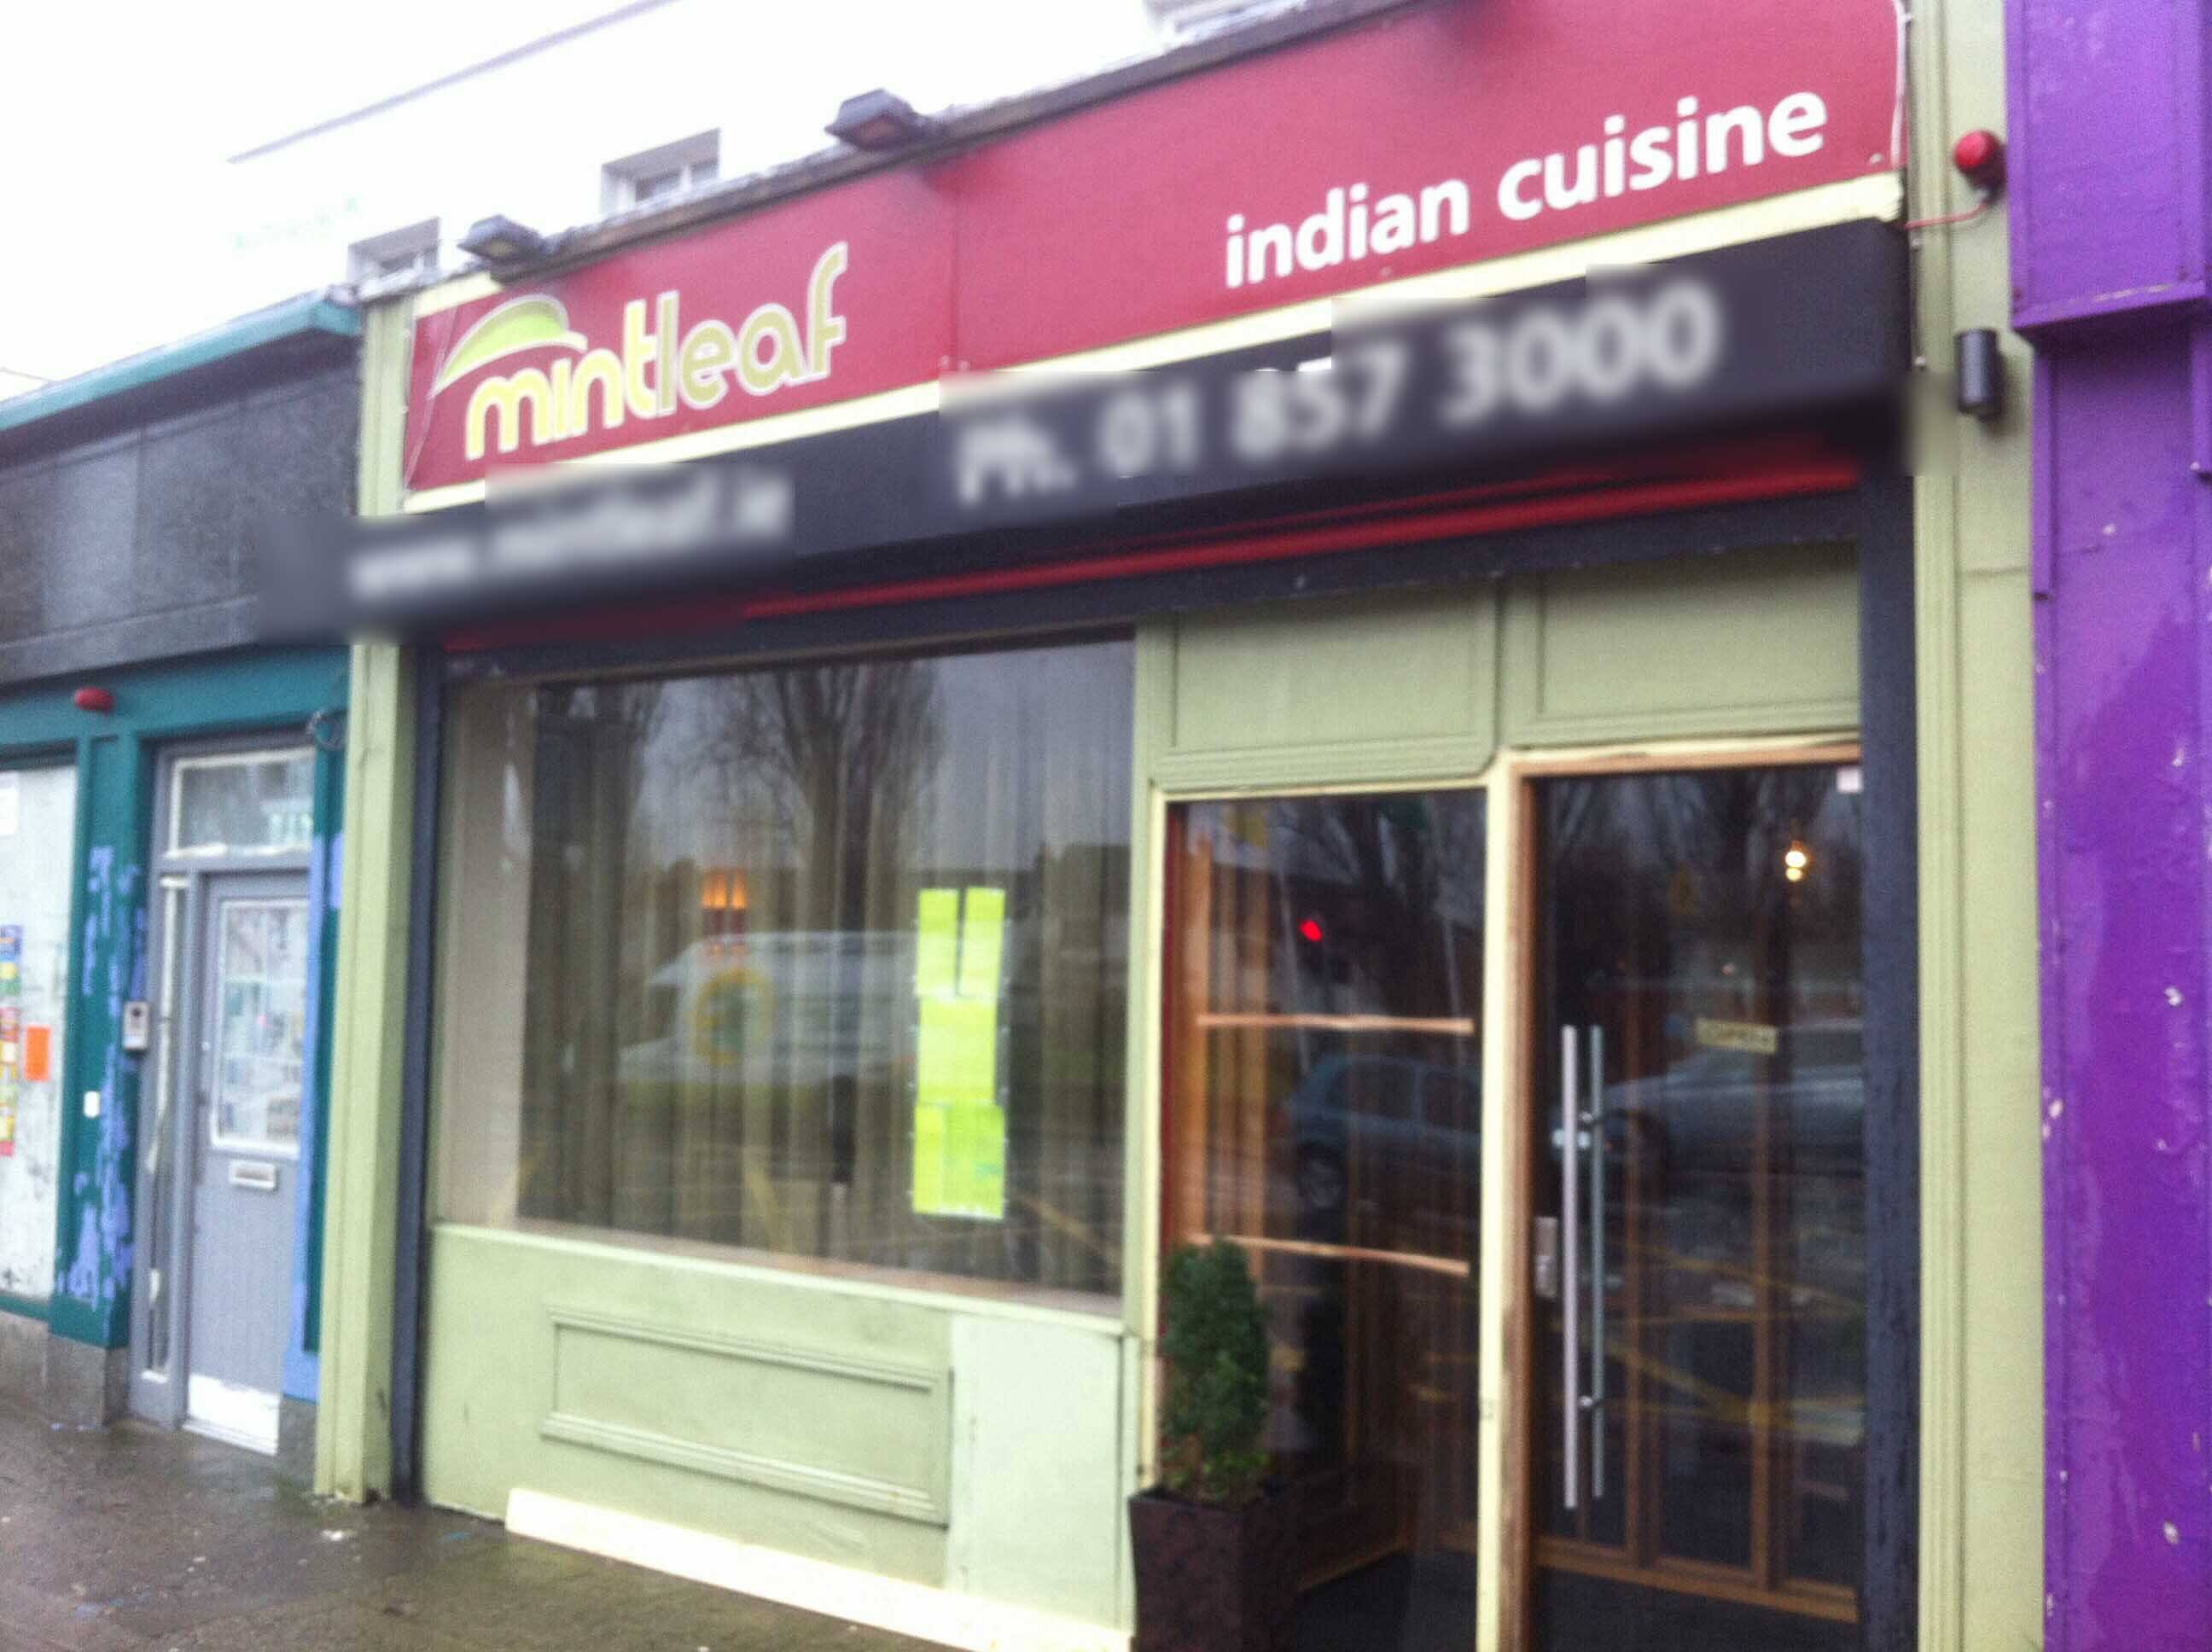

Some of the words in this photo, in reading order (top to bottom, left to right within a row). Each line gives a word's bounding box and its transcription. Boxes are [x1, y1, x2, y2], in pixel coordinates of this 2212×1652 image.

[1225, 175, 1470, 289] indian
[1497, 90, 1828, 222] cuisine
[464, 241, 848, 461] mintleaf
